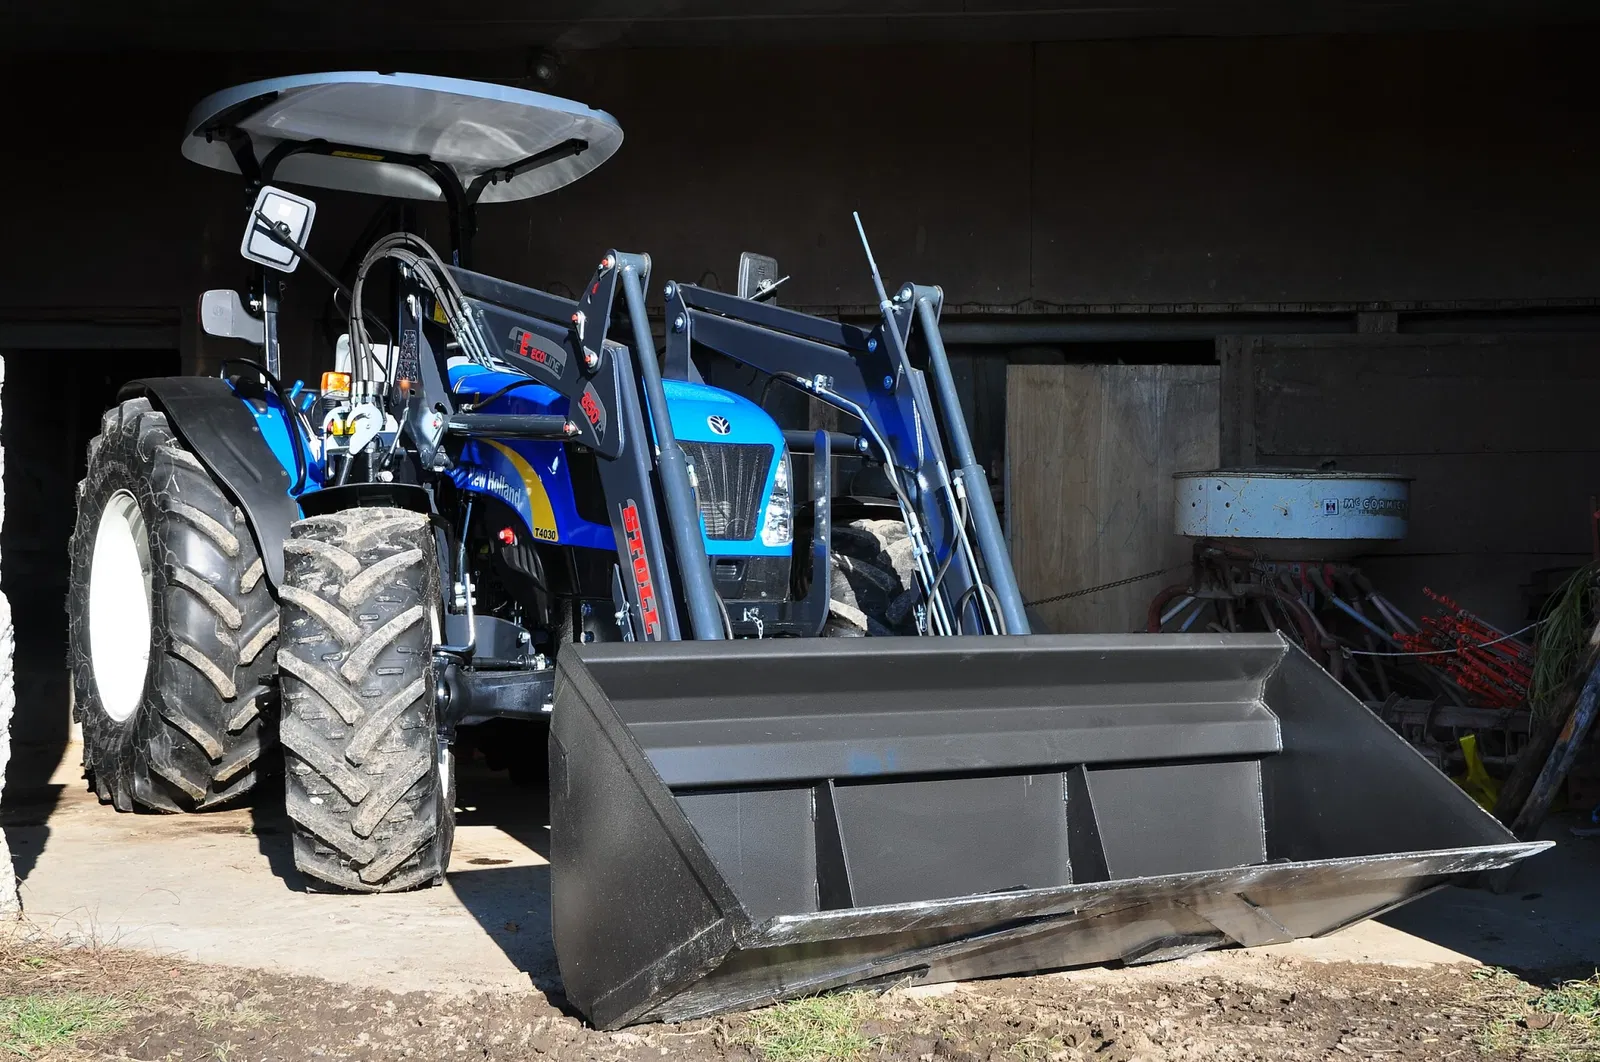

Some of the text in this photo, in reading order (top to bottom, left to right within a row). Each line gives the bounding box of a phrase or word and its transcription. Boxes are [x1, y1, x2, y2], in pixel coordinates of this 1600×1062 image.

[530, 347, 561, 373] ECOLINE
[487, 469, 521, 507] Holland
[535, 528, 556, 540] T4030
[622, 505, 659, 635] STOLL
